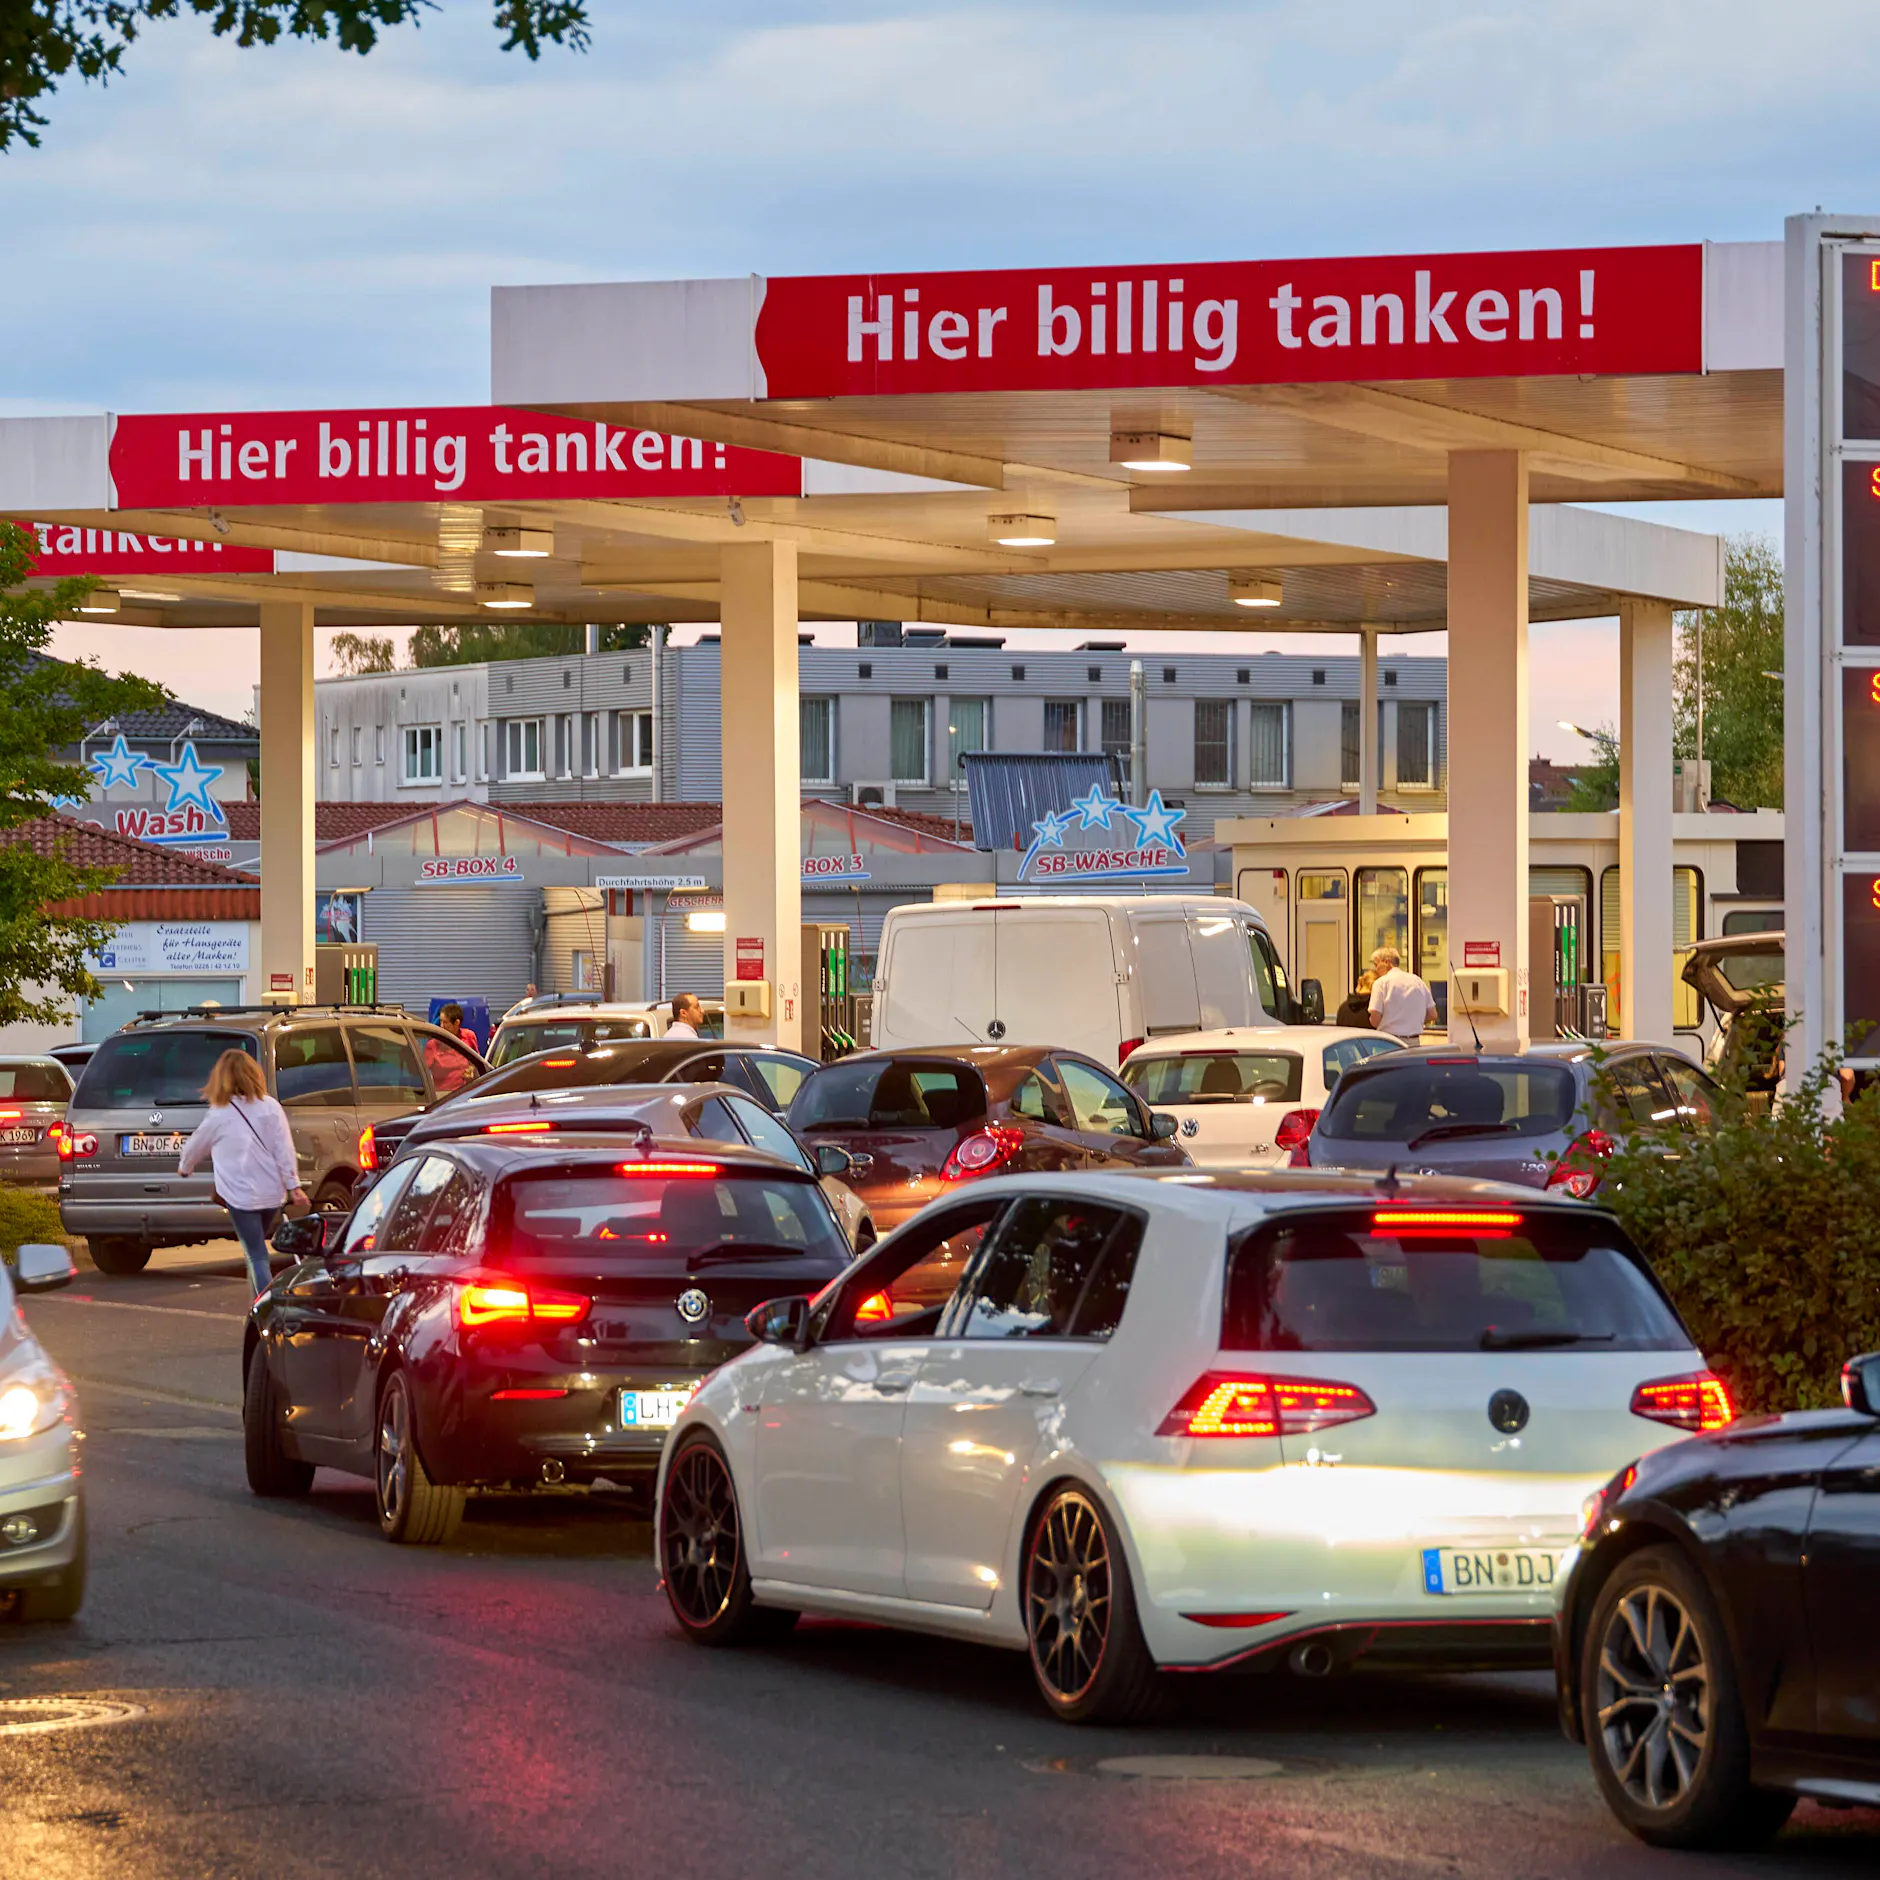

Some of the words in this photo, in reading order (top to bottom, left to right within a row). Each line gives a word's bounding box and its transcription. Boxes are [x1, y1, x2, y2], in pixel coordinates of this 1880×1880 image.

[847, 287, 1007, 362] Hier
[1038, 278, 1238, 371] billig
[1269, 268, 1597, 350] tanken!
[177, 424, 298, 481] Hier
[318, 419, 467, 491] billig
[489, 422, 727, 474] tanken!
[33, 522, 222, 554] tanke
[116, 804, 206, 837] Wash
[422, 857, 497, 878] SB-BOX
[502, 855, 518, 873] 4
[849, 854, 863, 871] 3
[1036, 848, 1168, 875] SB-WÄSCHE
[598, 878, 675, 886] Durchfahrtshöhe
[156, 923, 211, 935] Ersatzteile
[162, 938, 180, 951] für
[181, 937, 242, 950] Hausgeräte
[166, 951, 191, 960] aller
[192, 950, 237, 961] Marken!
[9, 1129, 34, 1141] 1969
[132, 1137, 149, 1151] BN
[640, 1397, 670, 1419] LH
[1453, 1553, 1495, 1586] BN
[1514, 1553, 1554, 1586] DJ
